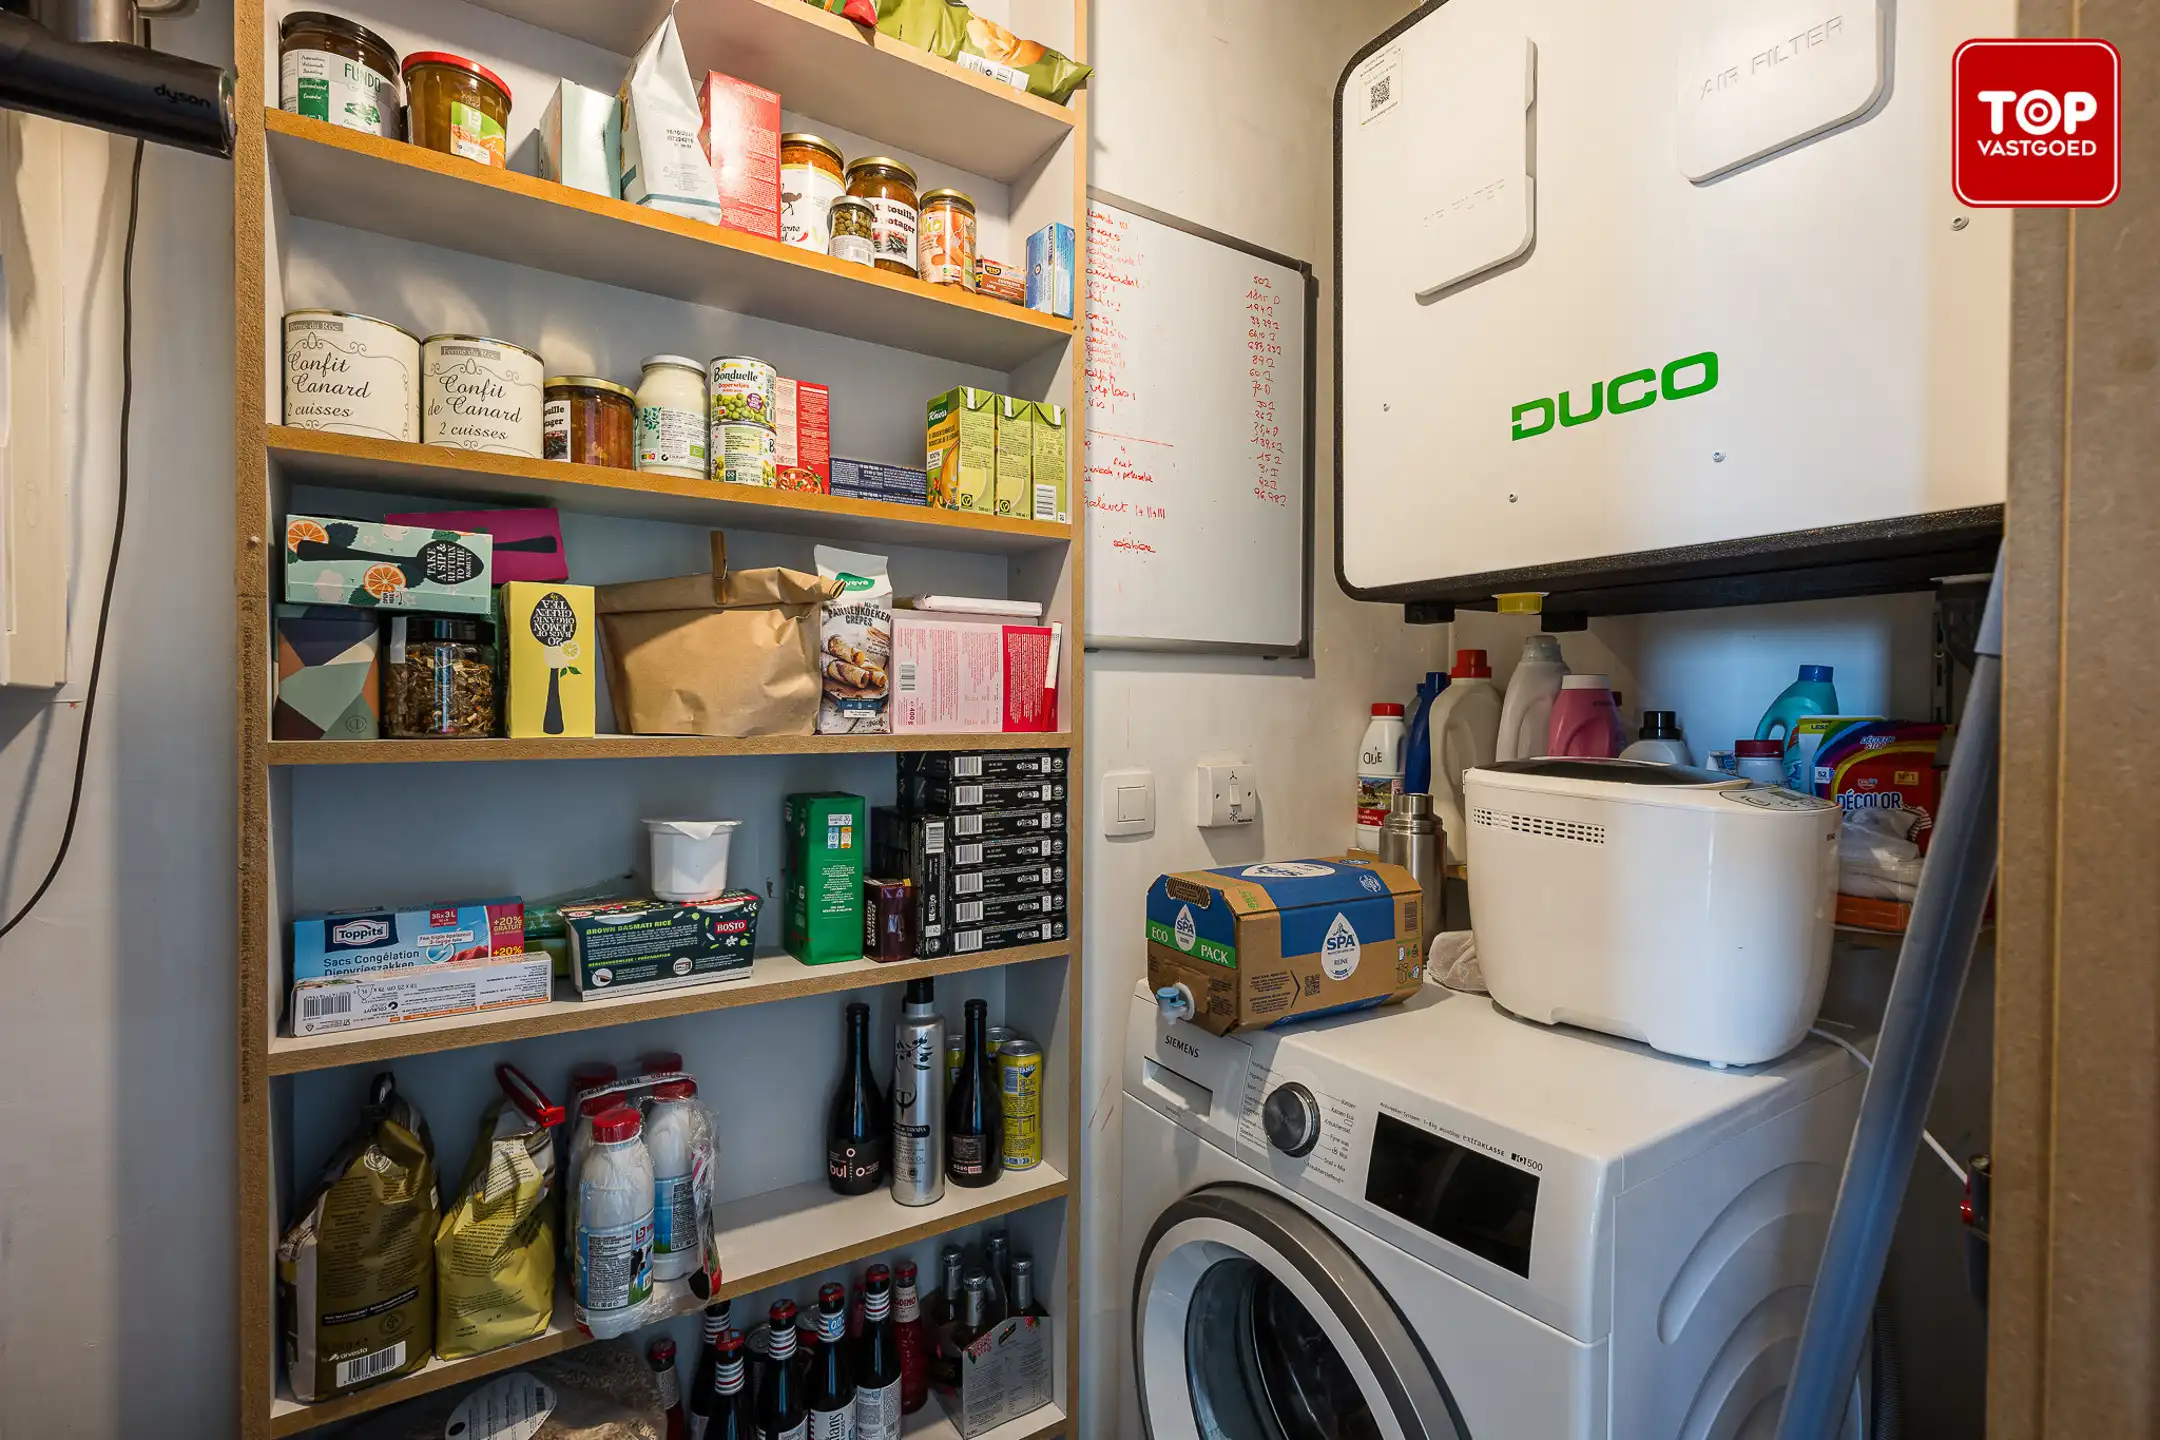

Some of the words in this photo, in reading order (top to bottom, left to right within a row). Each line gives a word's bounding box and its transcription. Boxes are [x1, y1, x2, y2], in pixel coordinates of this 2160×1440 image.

[1700, 66, 1738, 101] AIR
[1752, 15, 1842, 75] FILTER
[154, 82, 211, 109] dyson
[443, 346, 466, 356] Ferme
[288, 351, 350, 378] Confit
[714, 366, 759, 383] Bonduelle
[291, 373, 371, 398] Canard
[440, 374, 506, 402] Confit
[1512, 351, 1719, 441] DUCO
[294, 403, 353, 417] cuisses
[427, 399, 443, 416] de
[446, 396, 523, 423] Canard
[928, 409, 948, 422] Knorr
[439, 421, 446, 436] 2
[450, 425, 509, 440] cuisses
[436, 543, 447, 552] &
[427, 547, 436, 576] TAKE
[437, 553, 447, 572] SIP
[447, 544, 456, 582] RETURN
[456, 547, 465, 566] THE
[437, 573, 447, 582] A
[456, 568, 465, 581] TO
[535, 608, 573, 617] GREEN
[541, 600, 567, 609] TEA
[533, 616, 575, 624] ORGANIC
[828, 604, 891, 623] PANNENKOEKEN
[533, 622, 574, 632] LEMON
[547, 637, 563, 647] 20
[1836, 788, 1902, 811] DÉCOLOR
[493, 916, 522, 926] +20%
[493, 924, 522, 932] GRATUIT
[586, 927, 616, 936] BROWN
[617, 922, 653, 931] BASMATI
[654, 919, 672, 927] RICE
[717, 921, 745, 932] BOSTO
[1176, 919, 1195, 935] SPA
[339, 926, 384, 940] Toppits
[493, 945, 523, 957] +20%
[1151, 926, 1169, 943] ECO
[1200, 944, 1228, 964] PACK
[1327, 934, 1356, 951] SPA
[323, 958, 351, 968] Sacs
[354, 950, 420, 966] Congélation
[1164, 1035, 1200, 1058] SIEMENS
[340, 1347, 368, 1360] arvesta
